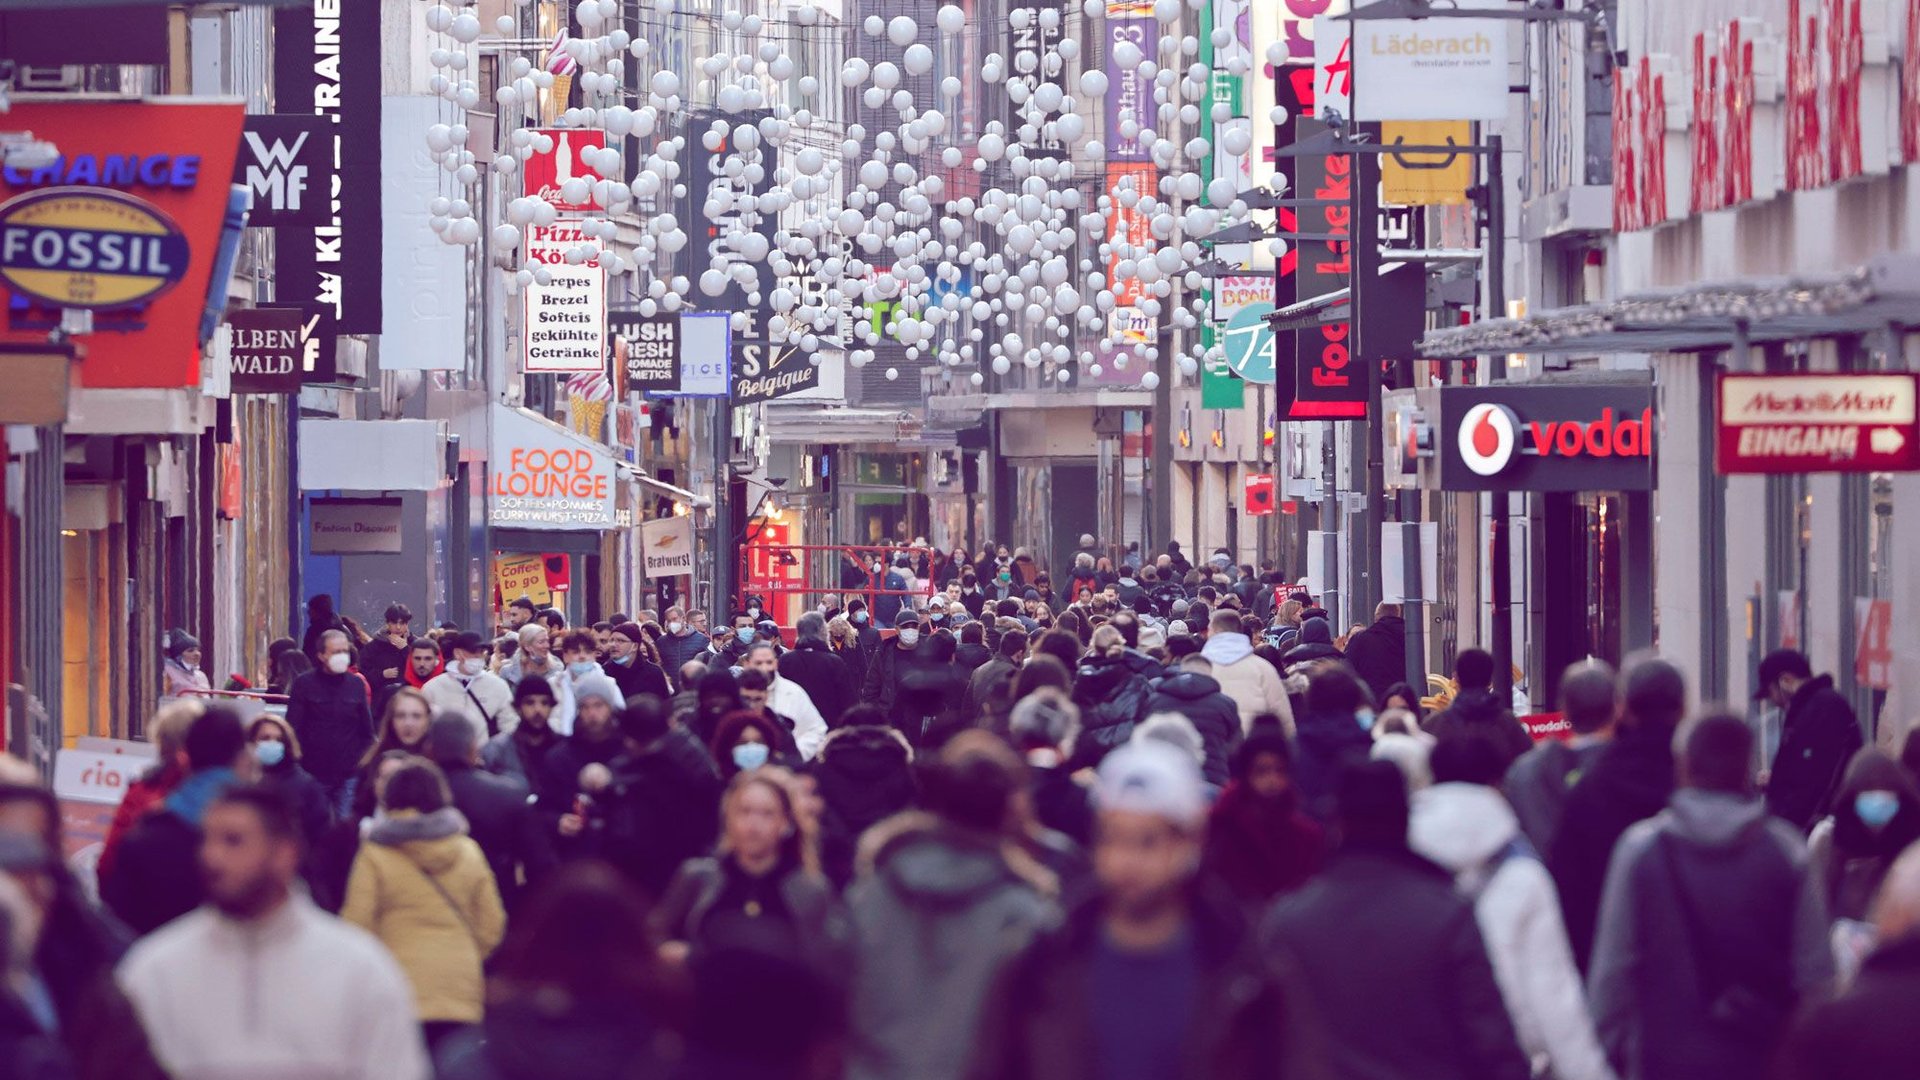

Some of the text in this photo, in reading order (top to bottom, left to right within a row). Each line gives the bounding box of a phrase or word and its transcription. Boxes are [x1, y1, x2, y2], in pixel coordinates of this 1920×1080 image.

[1371, 31, 1491, 56] Läderach
[243, 131, 309, 210] WMF
[1315, 152, 1350, 274] Locke
[4, 227, 171, 274] FOSSIL
[550, 277, 591, 289] repes
[541, 294, 588, 305] Brezel
[539, 311, 591, 323] Softeis
[531, 330, 598, 343] gekühlte
[529, 347, 600, 359] Getränke
[231, 355, 294, 374] WALD
[737, 367, 813, 397] Belgique
[1737, 426, 1859, 458] EINGANG
[510, 448, 593, 473] FOOD
[496, 472, 607, 499] LOUNGE
[551, 500, 604, 511] POMMES
[492, 510, 571, 522] CURRYWURST
[577, 513, 609, 523] PIZZA
[647, 553, 691, 568] Bratwurst
[501, 563, 540, 577] Coffee
[504, 580, 517, 589] to
[522, 576, 539, 588] go
[1531, 720, 1573, 733] vodafo
